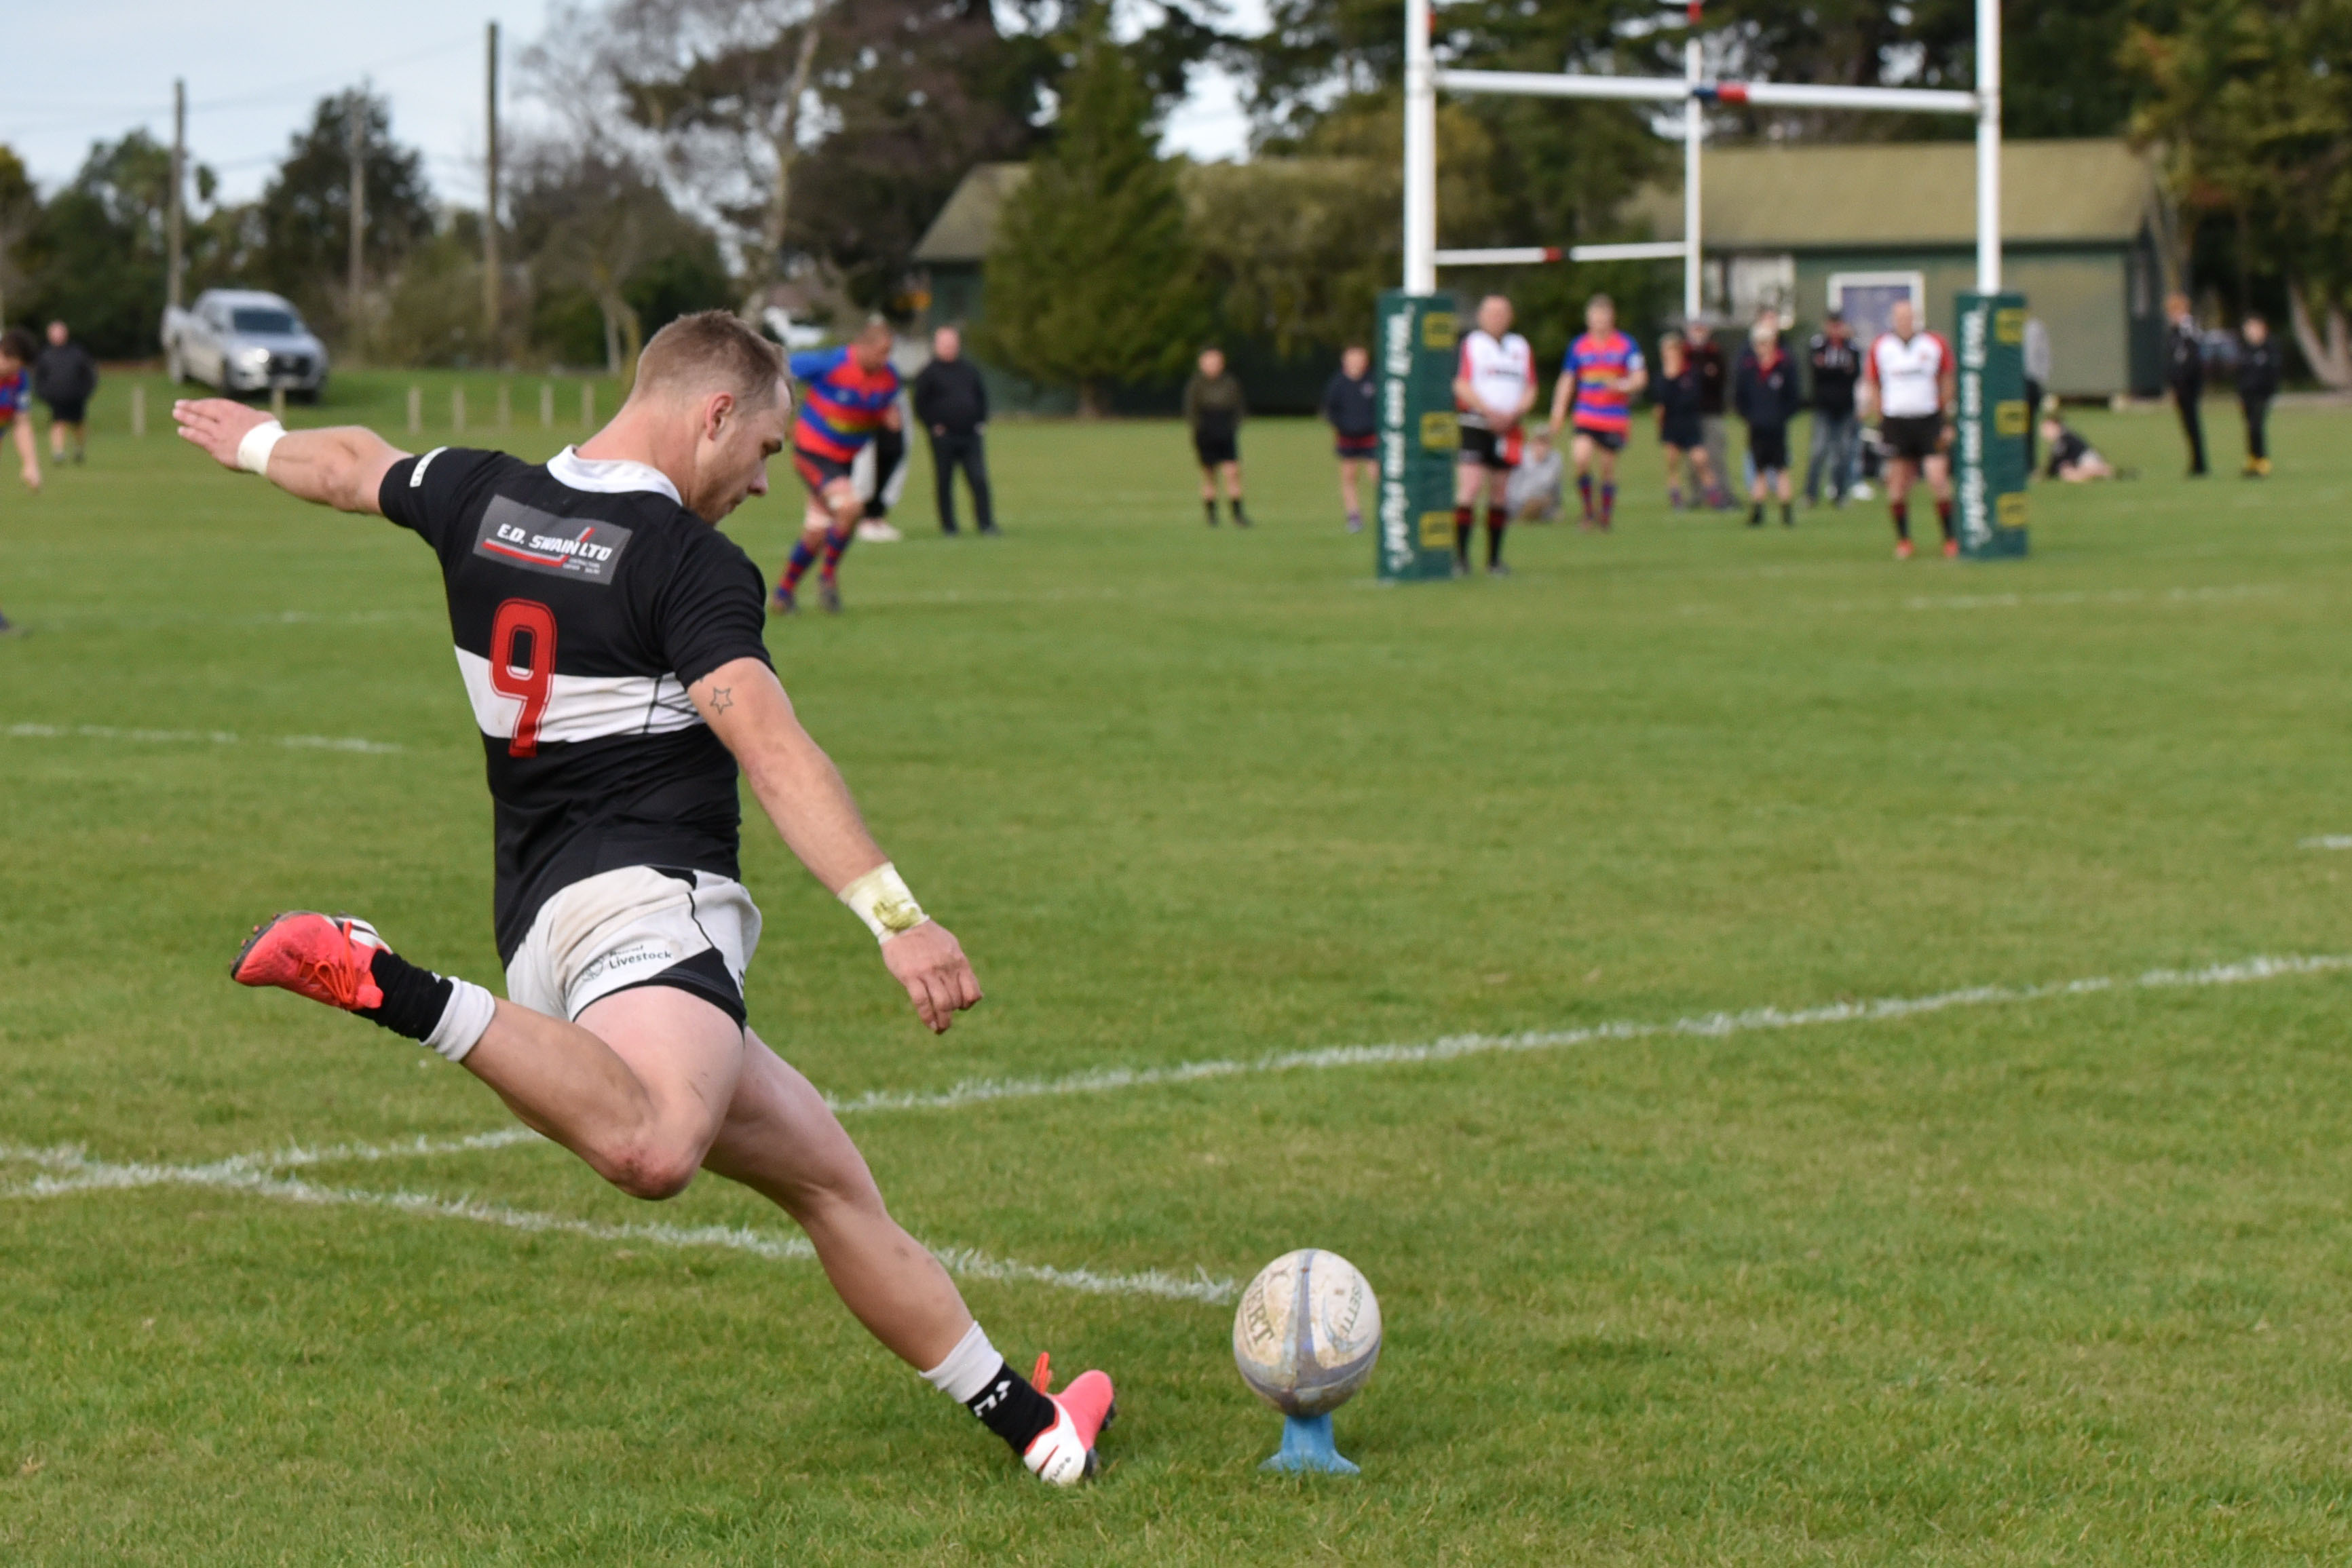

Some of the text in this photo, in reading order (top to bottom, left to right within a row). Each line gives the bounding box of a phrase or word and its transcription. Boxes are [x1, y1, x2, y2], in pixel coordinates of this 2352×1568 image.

[497, 523, 612, 561] E.D. SWAIN LTD
[489, 597, 558, 758] 9
[609, 950, 672, 970] Livestock
